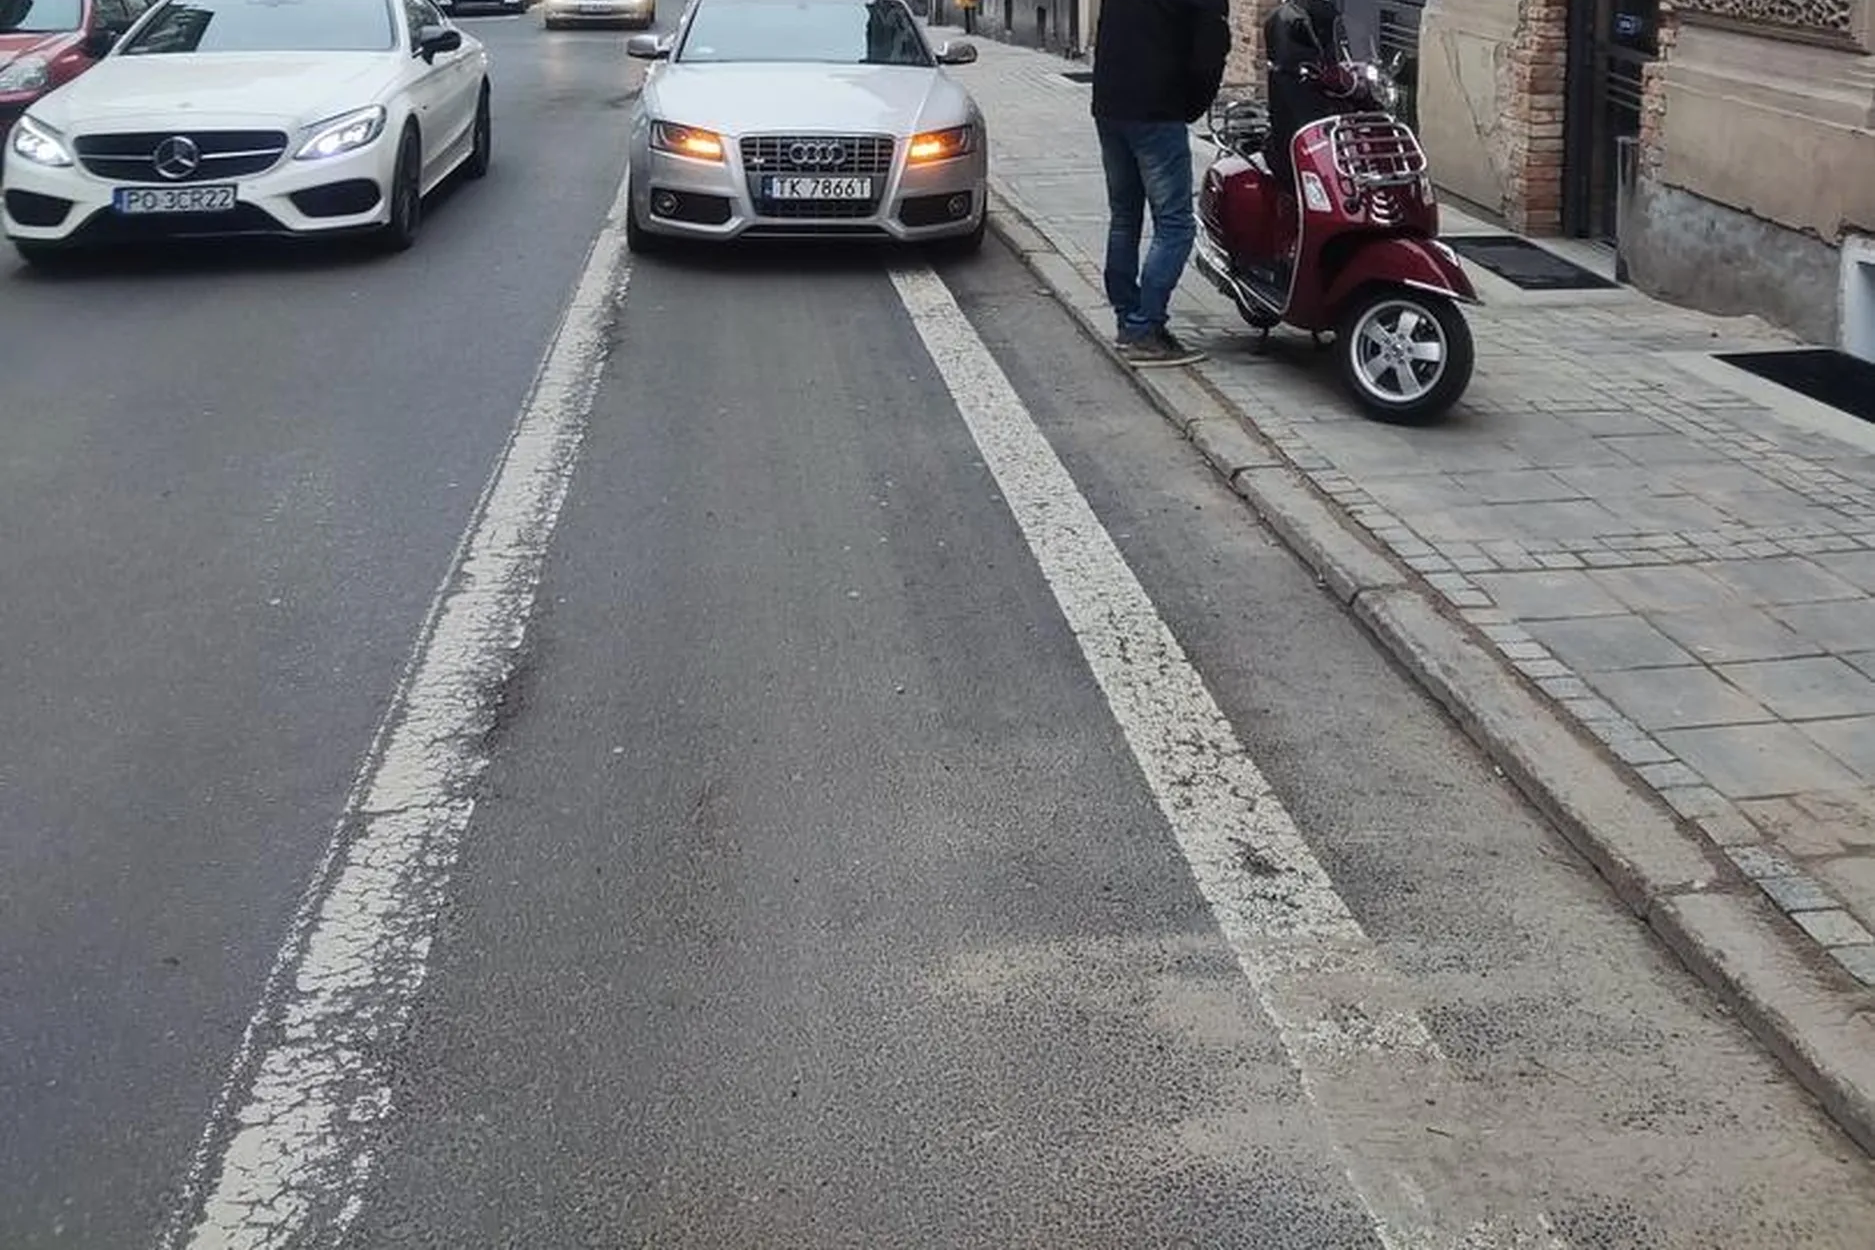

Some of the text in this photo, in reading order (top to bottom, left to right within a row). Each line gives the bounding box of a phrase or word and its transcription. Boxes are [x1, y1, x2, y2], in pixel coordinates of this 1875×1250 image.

[777, 179, 801, 196] TK
[129, 189, 231, 210] PO 3CR22
